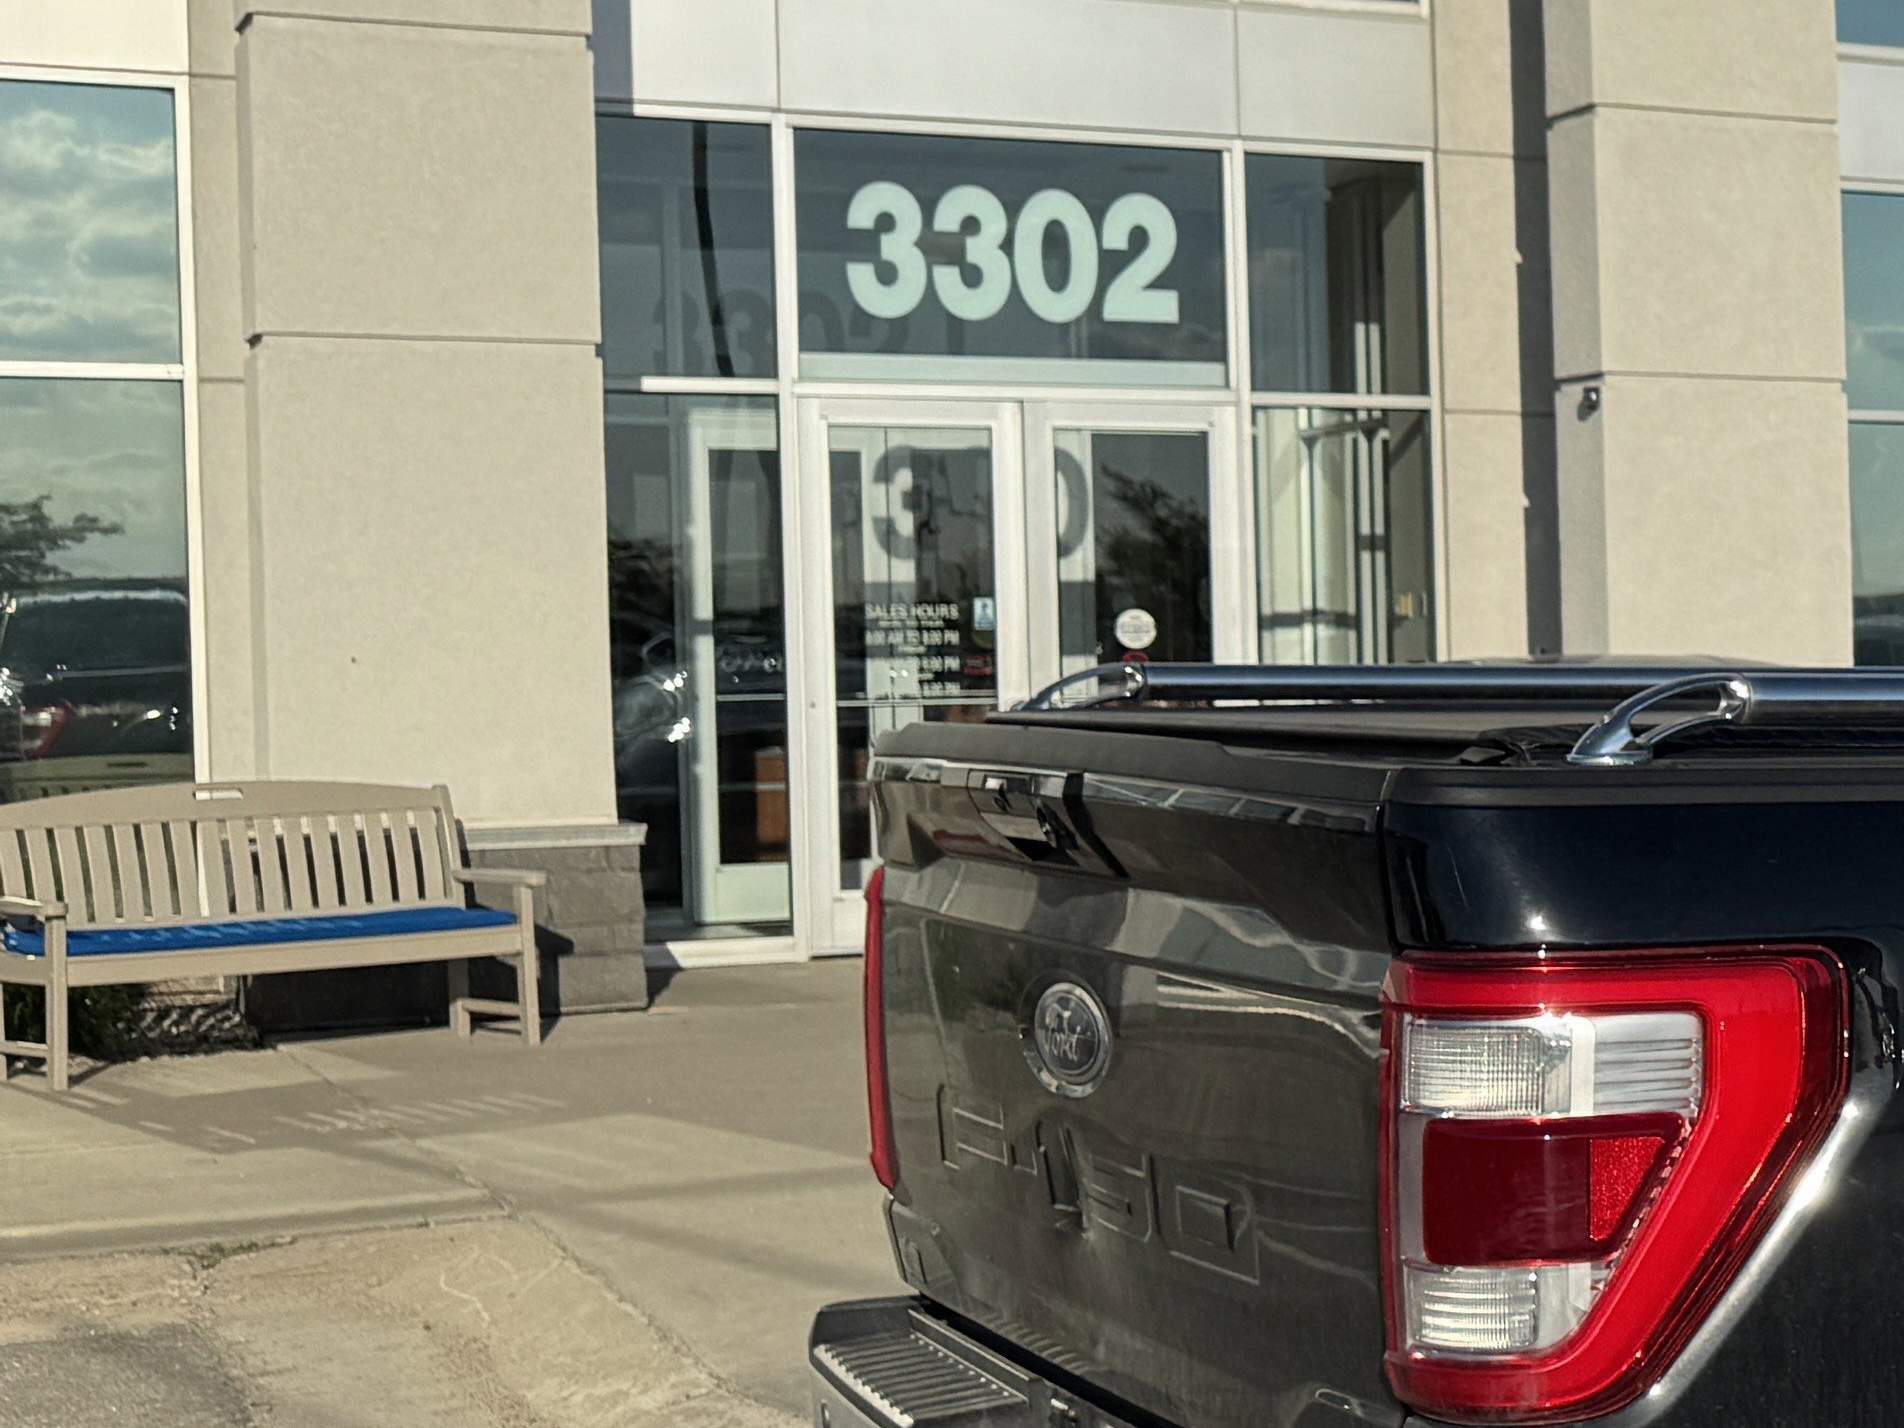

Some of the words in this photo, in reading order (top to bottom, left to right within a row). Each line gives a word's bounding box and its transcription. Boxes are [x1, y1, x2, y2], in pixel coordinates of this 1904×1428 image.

[845, 180, 1180, 325] 3302
[865, 603, 908, 621] SALES
[911, 603, 959, 621] HOURS
